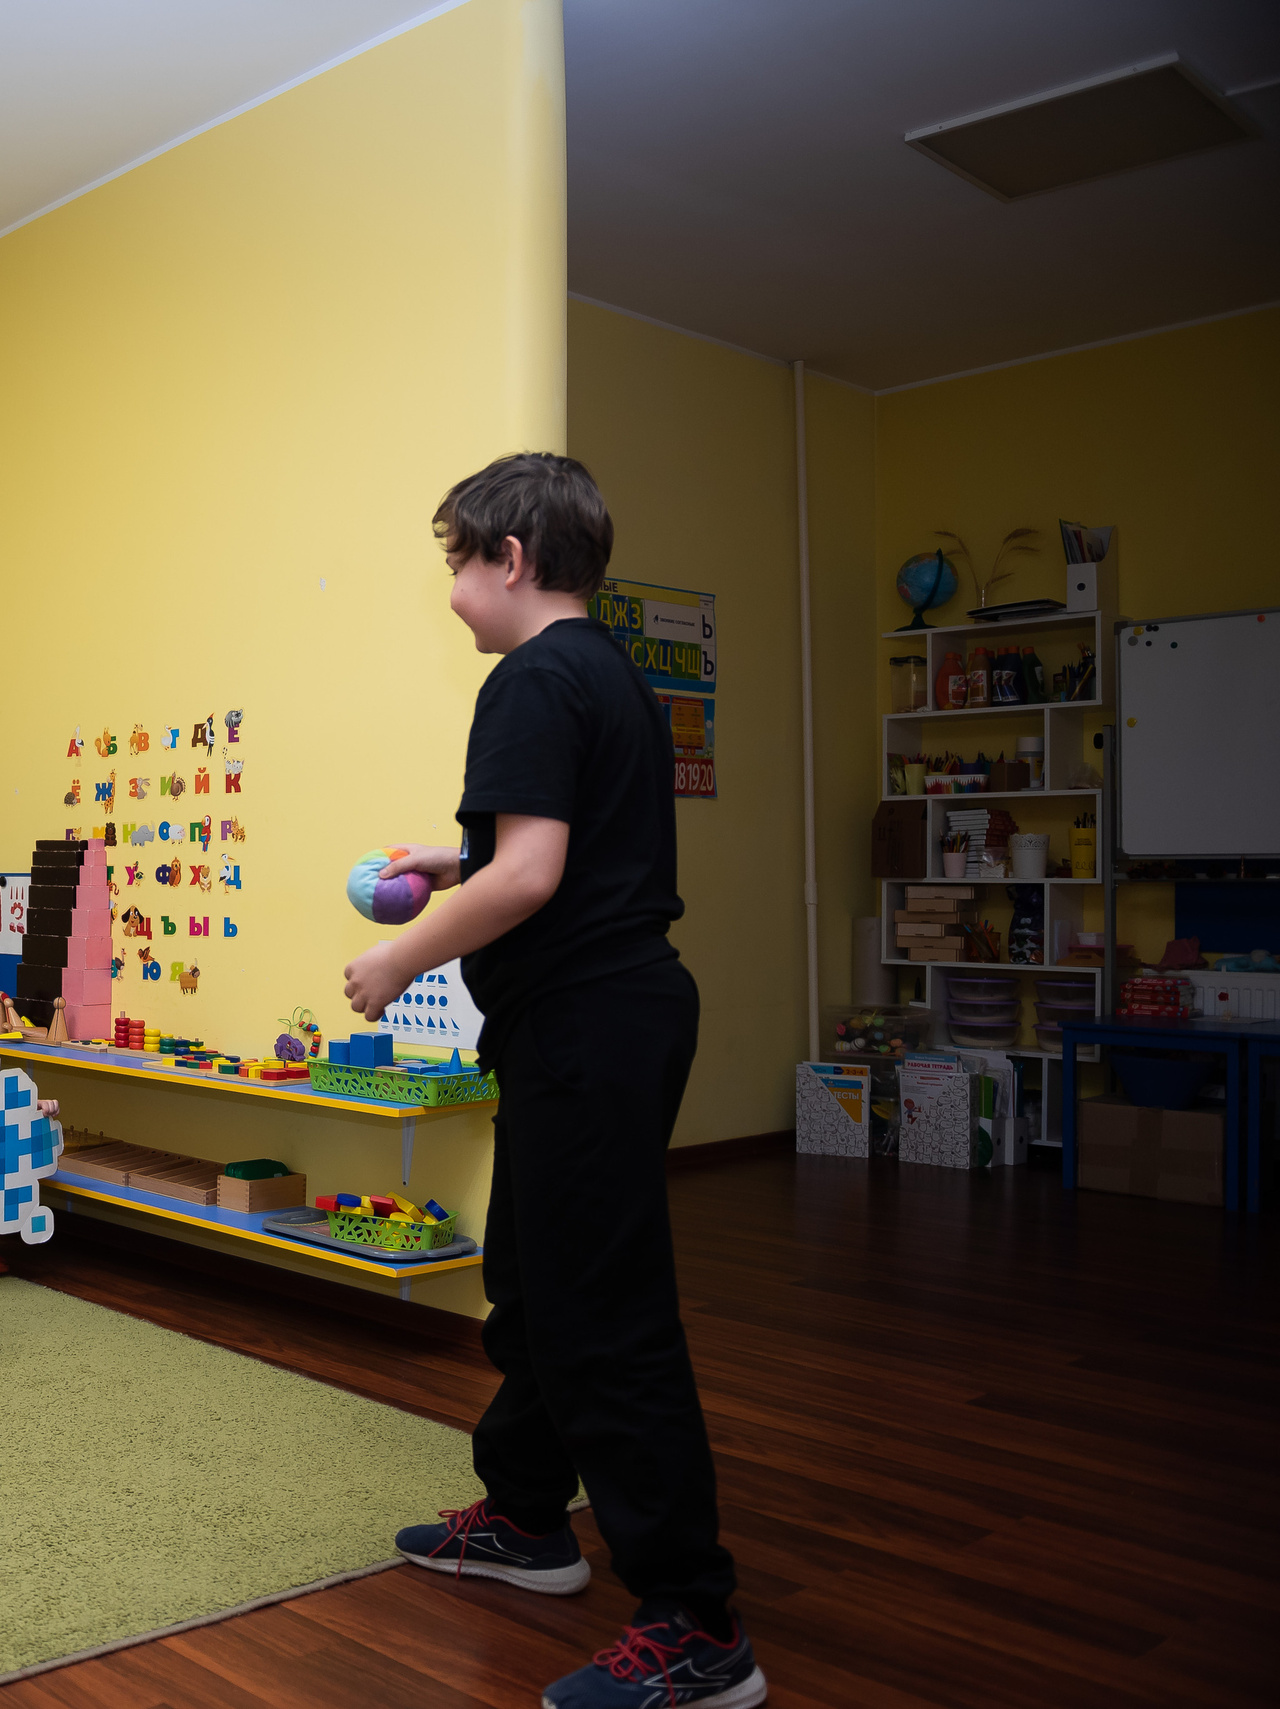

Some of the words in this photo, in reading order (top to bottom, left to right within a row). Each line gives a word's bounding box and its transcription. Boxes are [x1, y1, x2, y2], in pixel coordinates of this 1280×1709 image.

[600, 582, 618, 592] ЫЕ
[600, 600, 612, 628] Д
[614, 601, 628, 628] Ж
[631, 604, 641, 629] З
[645, 643, 657, 669] Х
[660, 645, 672, 675] Ц
[676, 647, 686, 673] Ч
[688, 649, 700, 678] Щ
[67, 739, 81, 757] А
[137, 732, 149, 751] В
[192, 723, 208, 748] Д
[228, 723, 240, 743] Е
[95, 783, 113, 801] Ж
[129, 778, 138, 797] З
[195, 767, 209, 794] Й
[226, 772, 241, 793] К
[675, 762, 686, 790] 18
[687, 763, 700, 790] 19
[701, 764, 714, 791] 20
[123, 824, 136, 843] Н
[159, 821, 171, 841] О
[190, 822, 204, 842] П
[221, 820, 233, 840] Р
[125, 866, 138, 885] У
[155, 864, 172, 885] Ф
[189, 865, 205, 885] Х
[225, 865, 241, 889] Ц
[161, 916, 176, 935] Ъ
[190, 916, 209, 936] Ы
[224, 917, 238, 937] Ь
[143, 961, 161, 981] Ю
[833, 1091, 860, 1100] ТЕСТЫ
